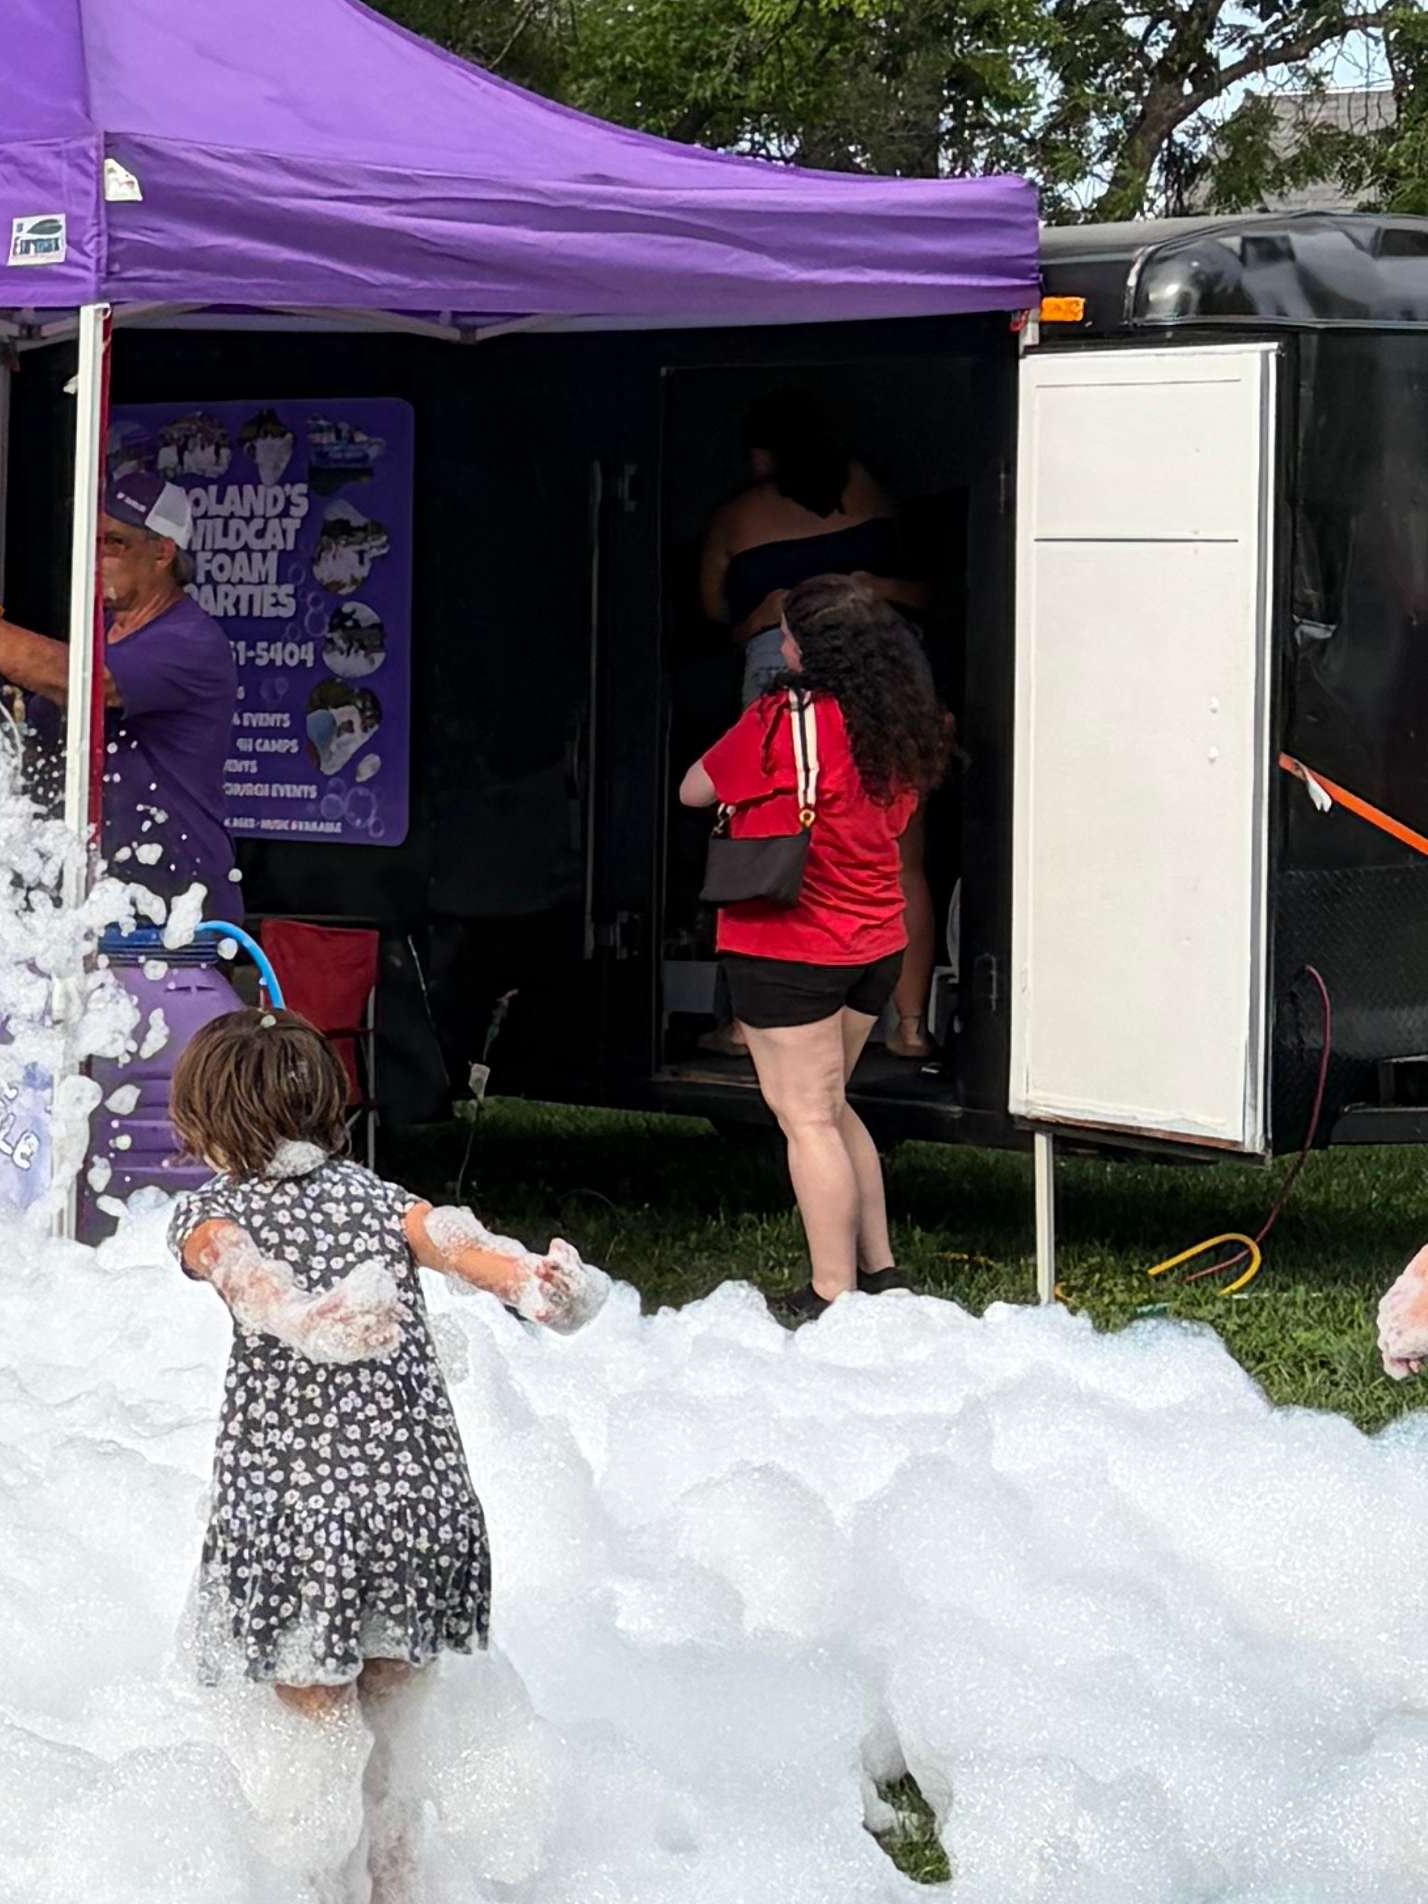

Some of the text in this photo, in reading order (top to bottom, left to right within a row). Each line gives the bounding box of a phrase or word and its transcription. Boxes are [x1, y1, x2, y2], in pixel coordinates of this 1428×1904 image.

[188, 483, 309, 519] OLAND'S
[196, 550, 280, 585] FOAM
[230, 641, 315, 668] 1-5404
